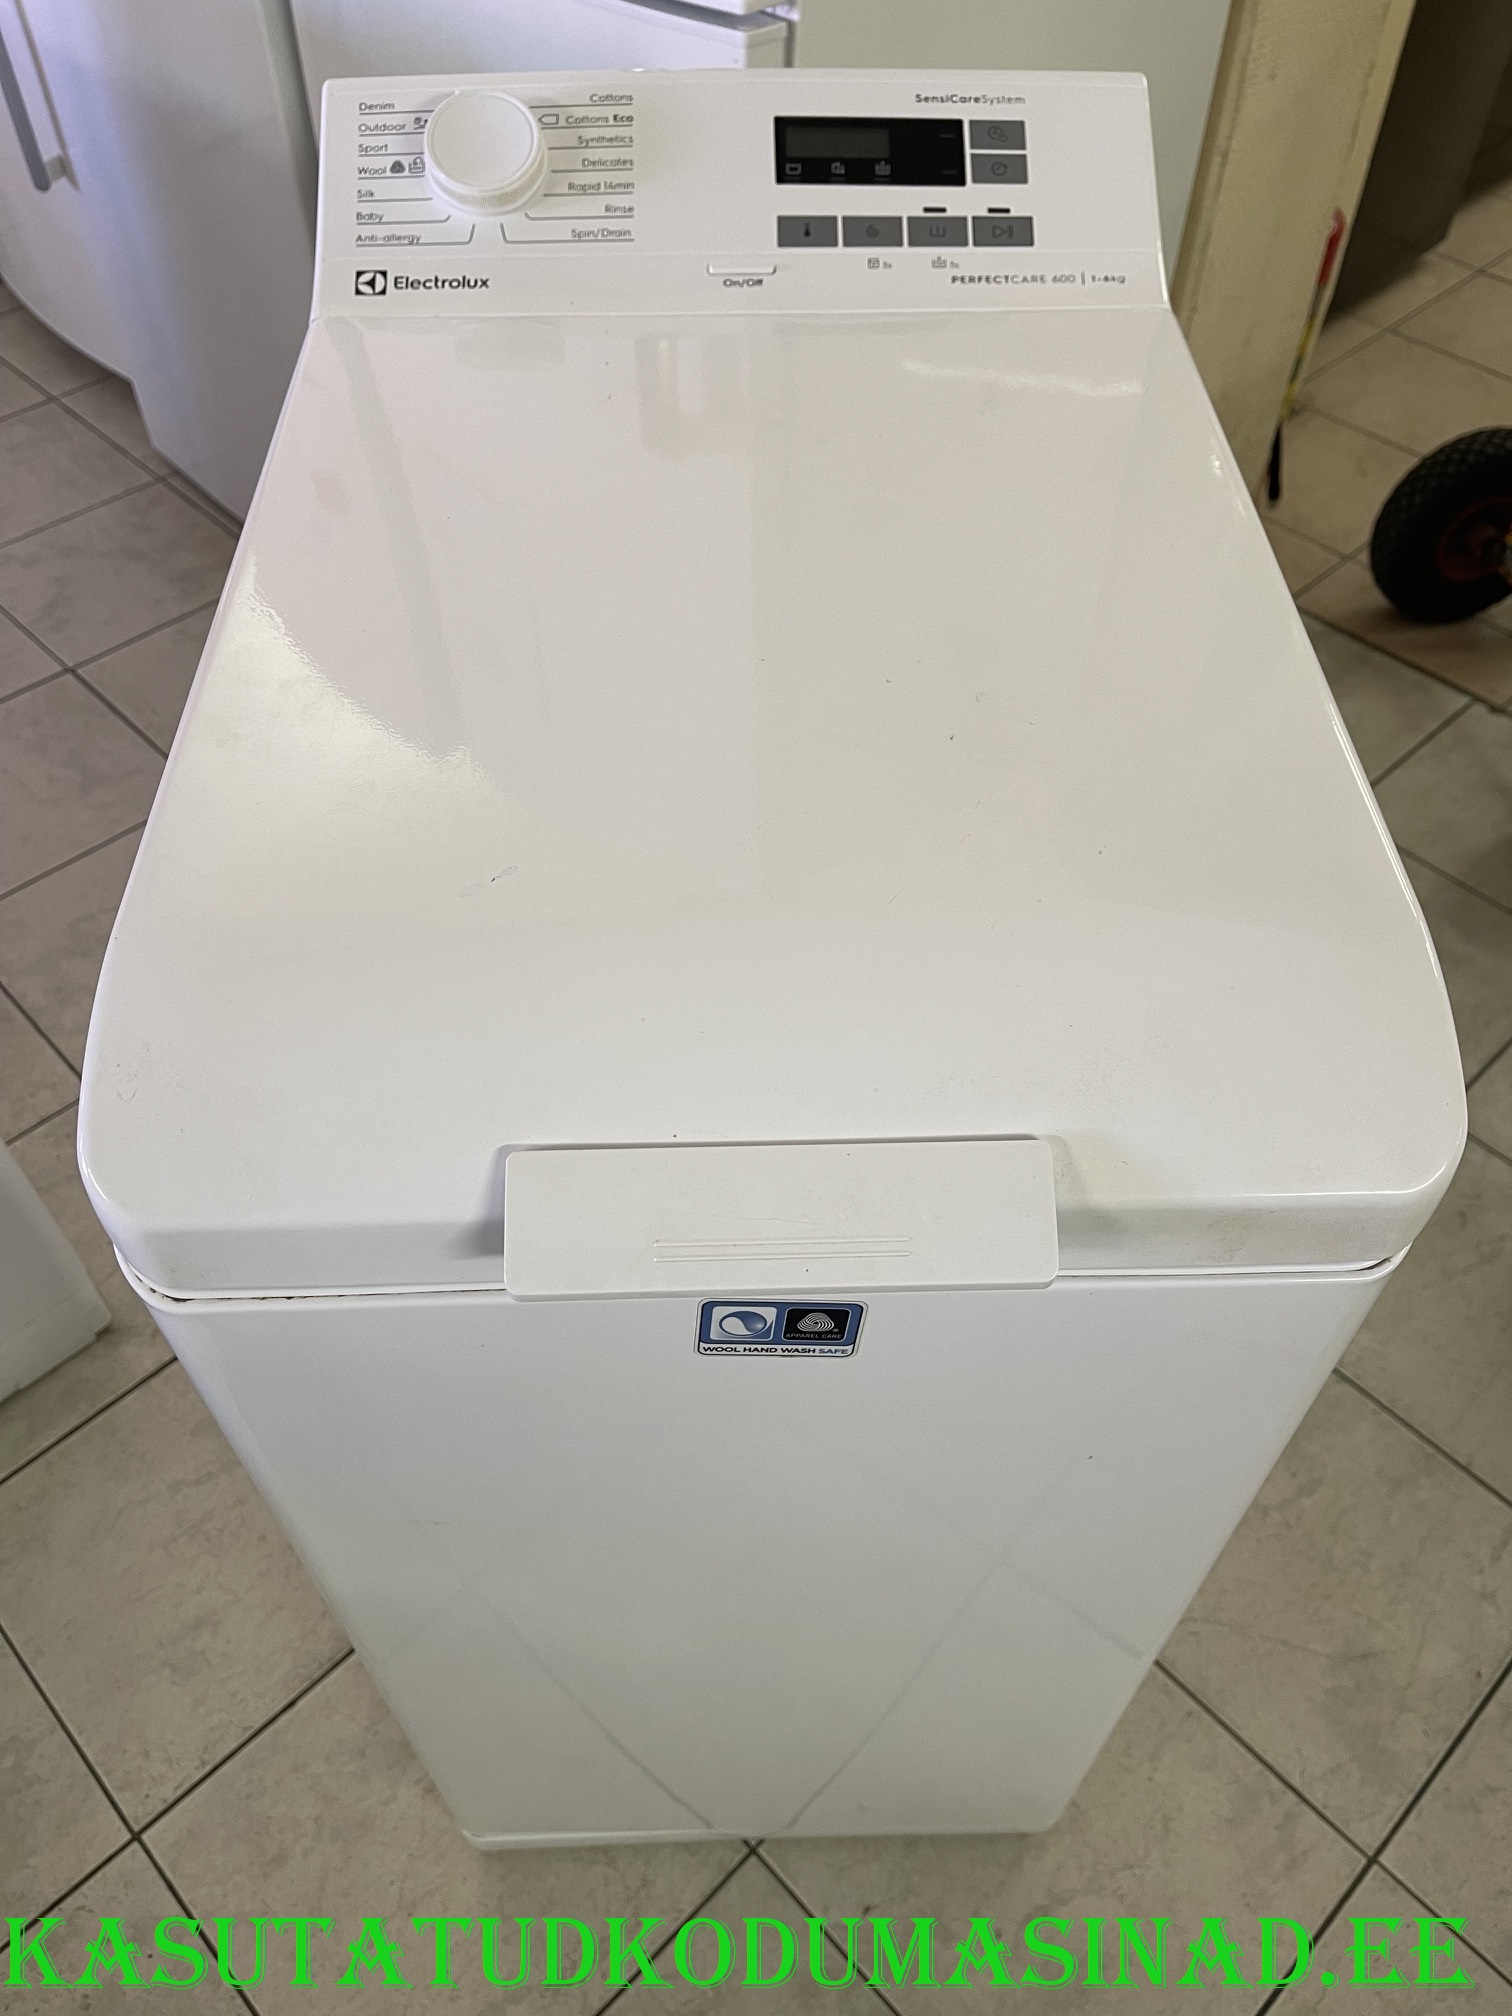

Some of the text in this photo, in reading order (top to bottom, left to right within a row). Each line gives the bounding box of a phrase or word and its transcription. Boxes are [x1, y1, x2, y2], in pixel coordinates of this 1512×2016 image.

[589, 93, 634, 103] Cottons
[914, 93, 1026, 106] SensiCareSystem
[358, 101, 395, 111] Denim
[565, 113, 635, 125] Cottons Eco
[358, 122, 407, 133] Outdoor
[577, 134, 634, 147] Synthetics
[358, 142, 389, 154] Sport
[581, 157, 634, 168] Delicates
[357, 165, 388, 176] Wool
[567, 181, 602, 193] Rapid
[356, 189, 375, 199] Silk
[604, 204, 635, 214] Rinse
[356, 211, 385, 223] Baby
[356, 233, 422, 245] Anti-allergy
[570, 227, 632, 239] Spin/Drain
[393, 275, 490, 291] Electrolux
[722, 277, 764, 288] On/Off
[950, 273, 1048, 285] PERFECTCARE
[1050, 273, 1077, 285] 600
